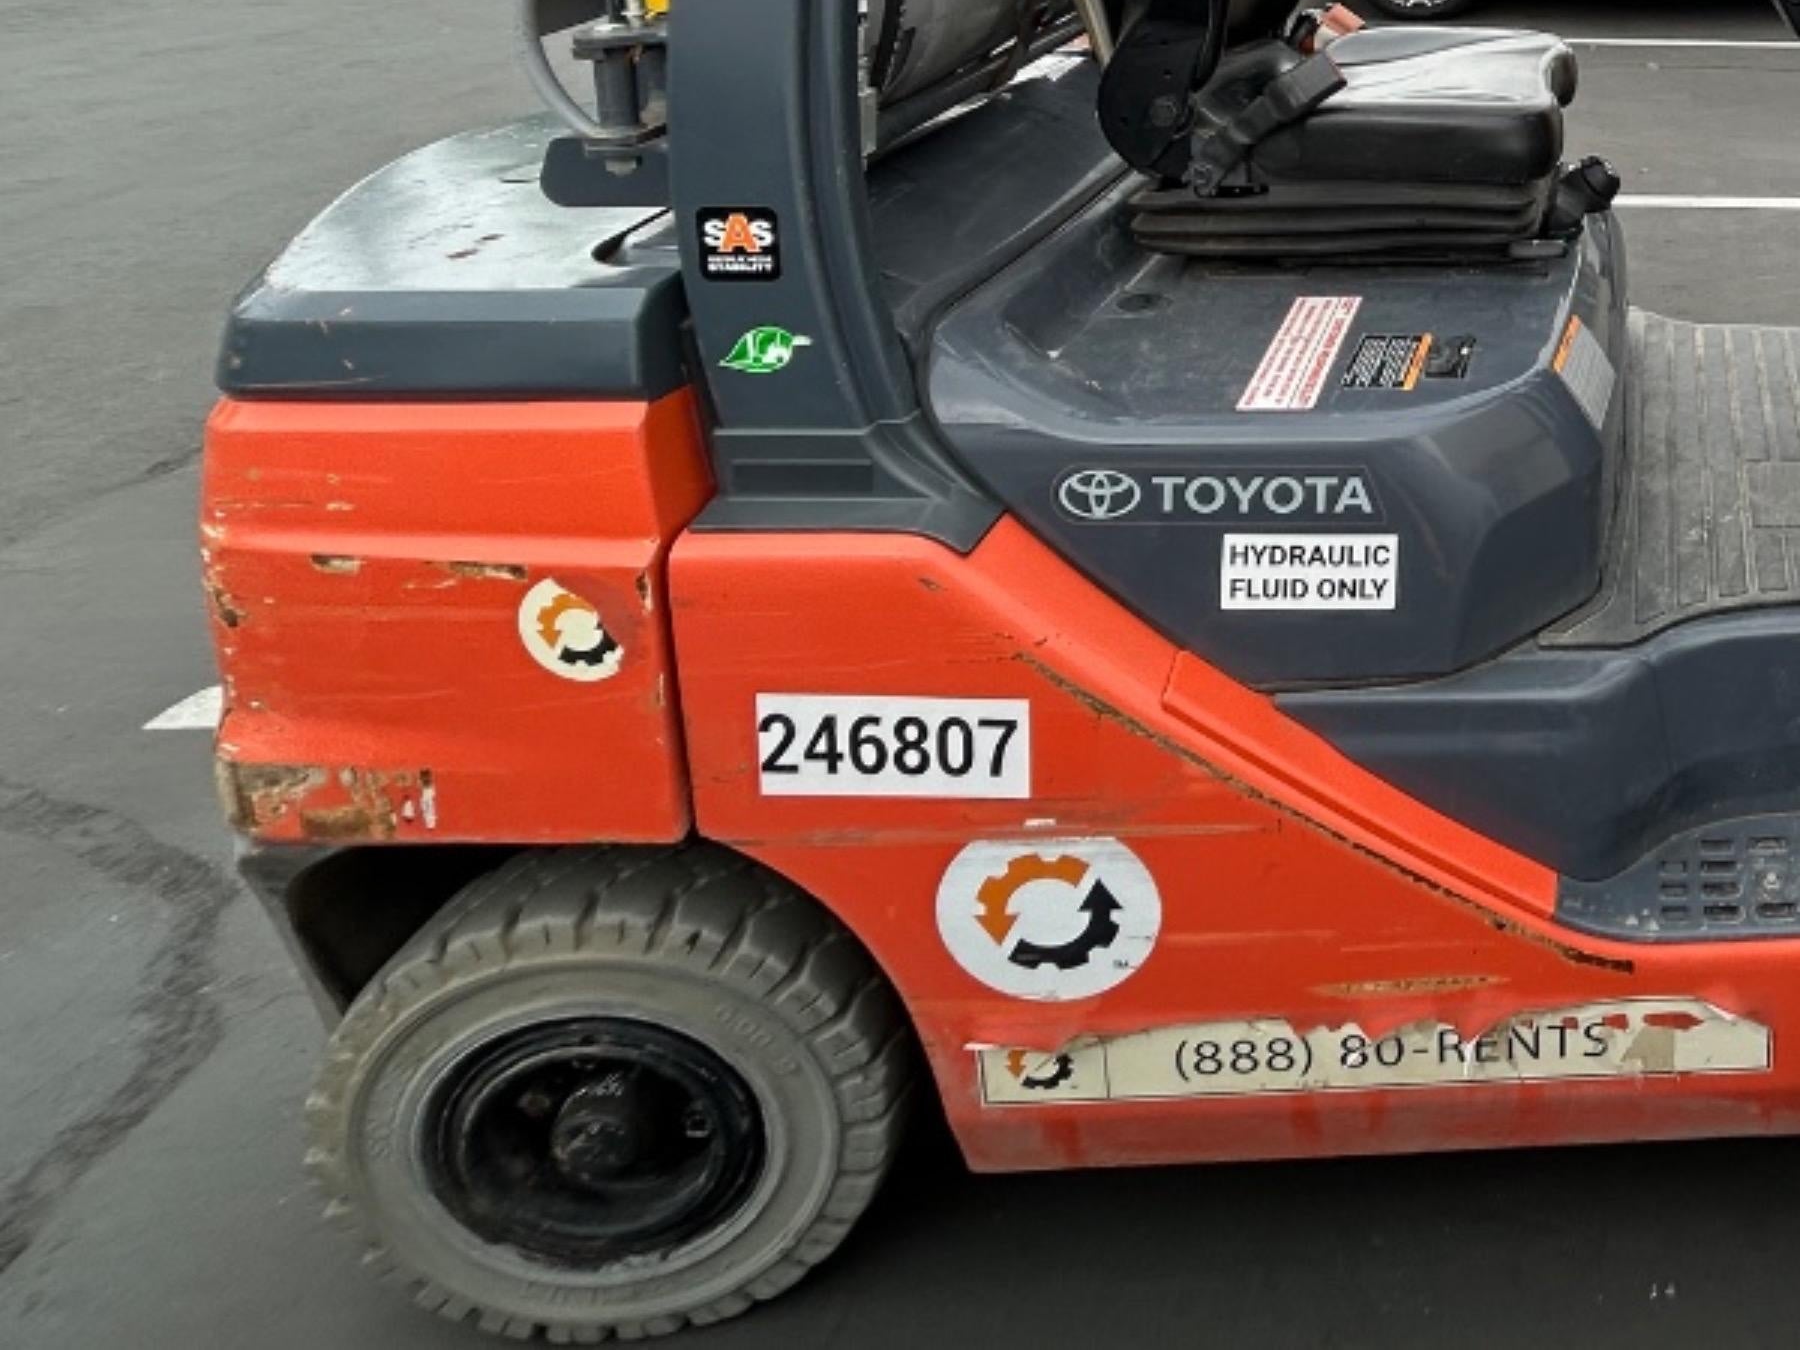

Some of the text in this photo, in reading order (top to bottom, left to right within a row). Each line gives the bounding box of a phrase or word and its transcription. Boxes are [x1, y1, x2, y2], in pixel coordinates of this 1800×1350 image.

[703, 212, 775, 253] SAS
[1152, 476, 1373, 514] TOYOTA
[1229, 545, 1390, 567] HYDRAULIC
[1229, 578, 1389, 601] FLUID ONLY
[758, 713, 1019, 778] 246807
[1175, 1021, 1611, 1082] (888) 80-RENTS
